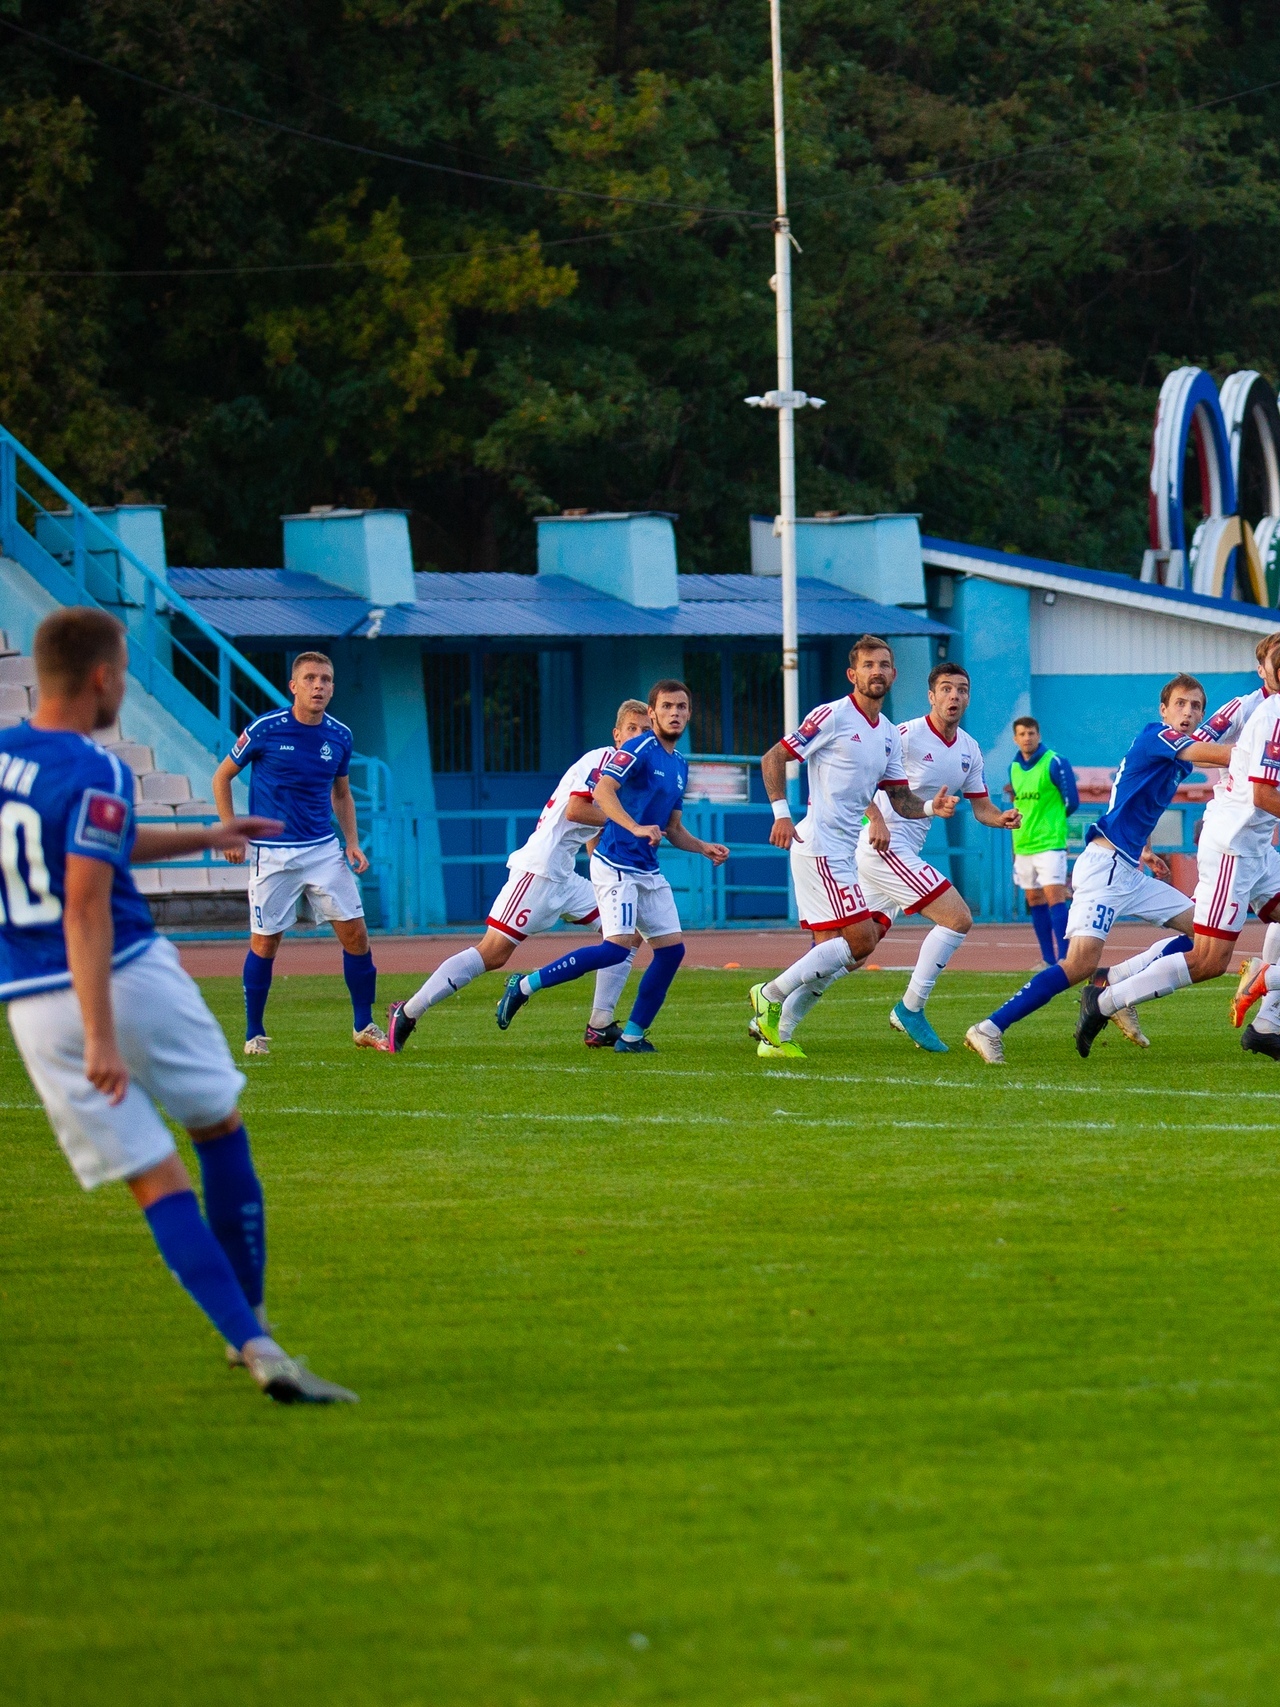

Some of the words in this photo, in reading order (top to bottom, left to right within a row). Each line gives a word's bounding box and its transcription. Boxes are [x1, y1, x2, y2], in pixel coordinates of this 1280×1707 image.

[1021, 791, 1041, 800] JAKO
[0, 800, 62, 927] 0
[918, 864, 940, 888] 17
[839, 883, 866, 912] 59
[515, 908, 532, 928] 6
[621, 902, 633, 927] 11
[1092, 903, 1115, 933] 33
[1228, 903, 1240, 926] 7
